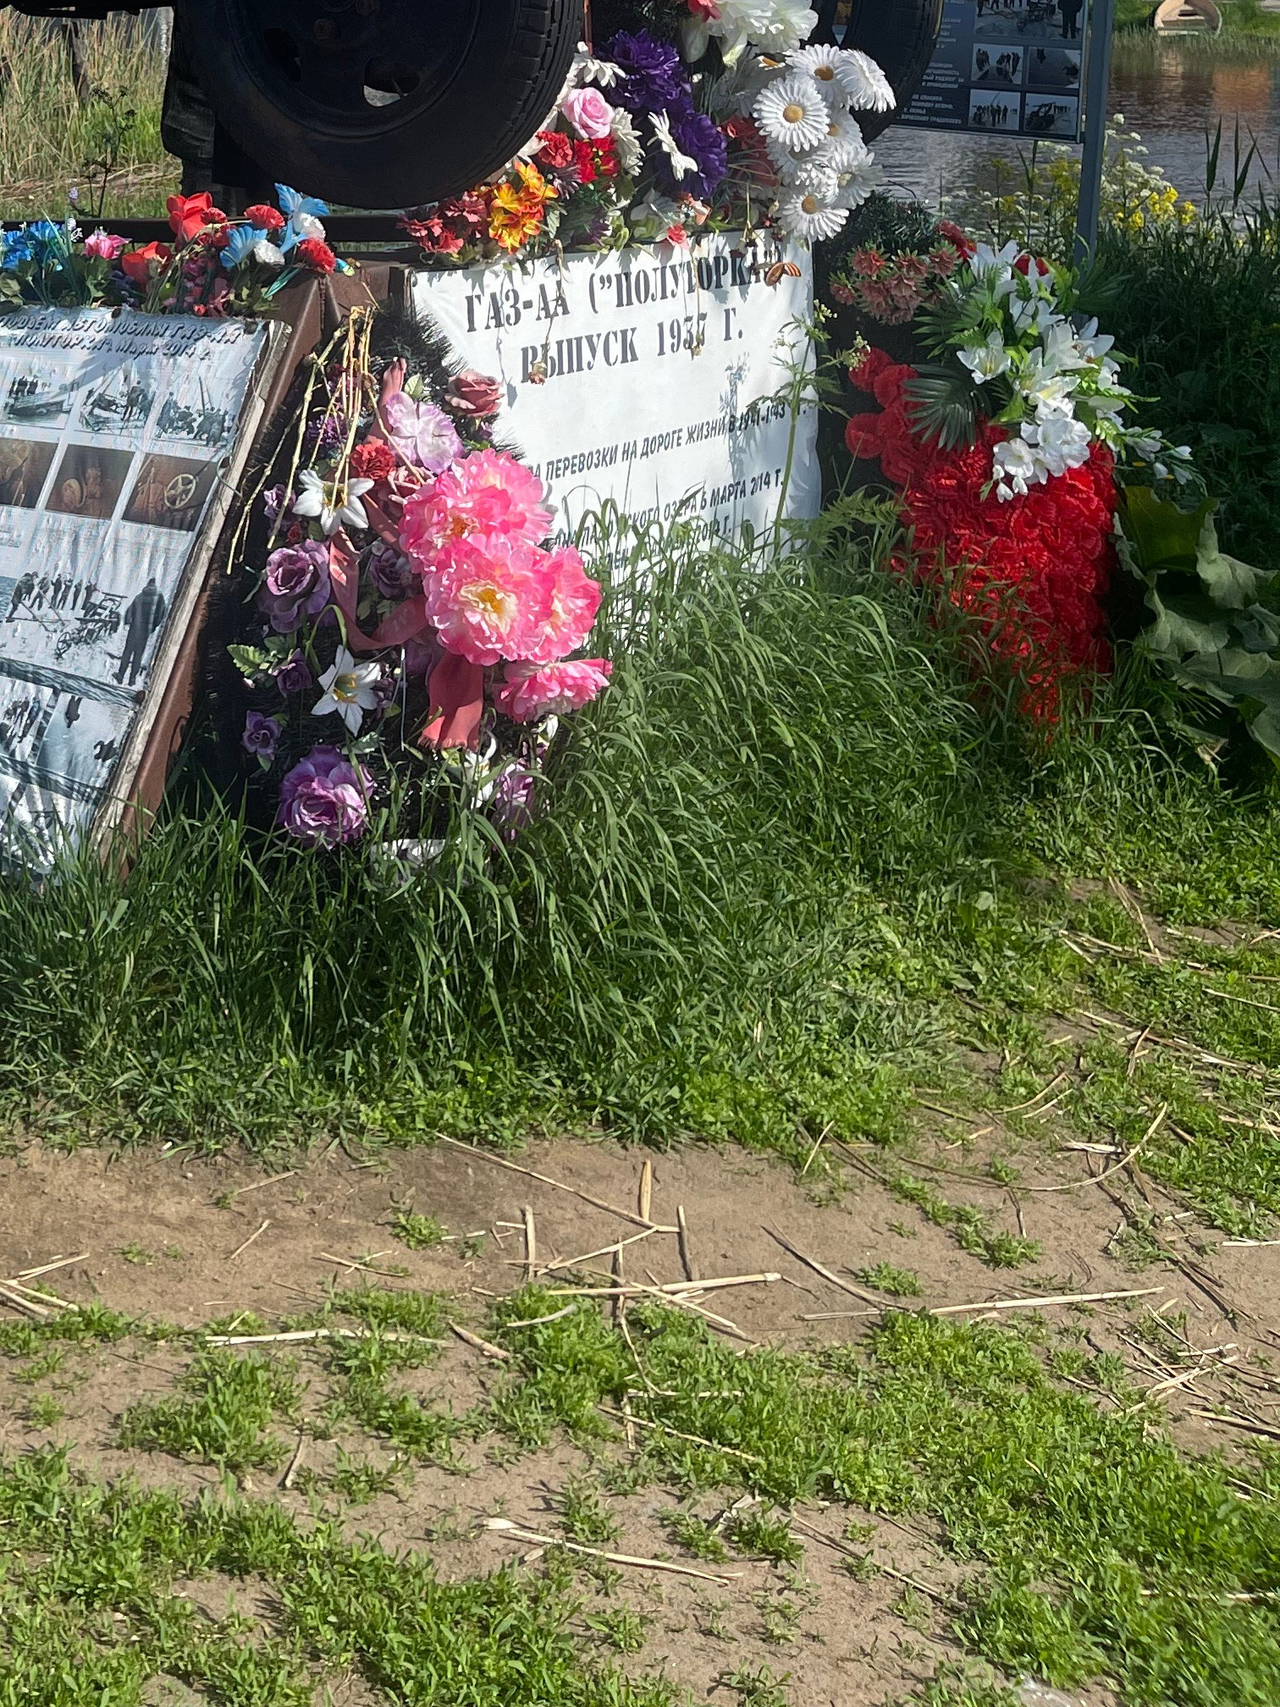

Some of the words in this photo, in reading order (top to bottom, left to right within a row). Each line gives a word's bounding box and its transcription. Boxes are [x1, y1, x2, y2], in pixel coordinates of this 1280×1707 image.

[61, 318, 169, 338] АВТОМОБИЛЯ
[170, 323, 241, 345] ГАЗ-АА
[465, 280, 570, 333] ГАЗ-АА
[521, 327, 638, 384] ВЫПУСК
[724, 307, 743, 341] Г.
[545, 444, 618, 481] ПЕРЕВОЗКИ
[621, 441, 638, 462] НА
[640, 427, 683, 460] ДОРОГЕ
[685, 416, 726, 445] ЖИЗНИ
[728, 414, 736, 433] В
[710, 479, 746, 508] МАРТА
